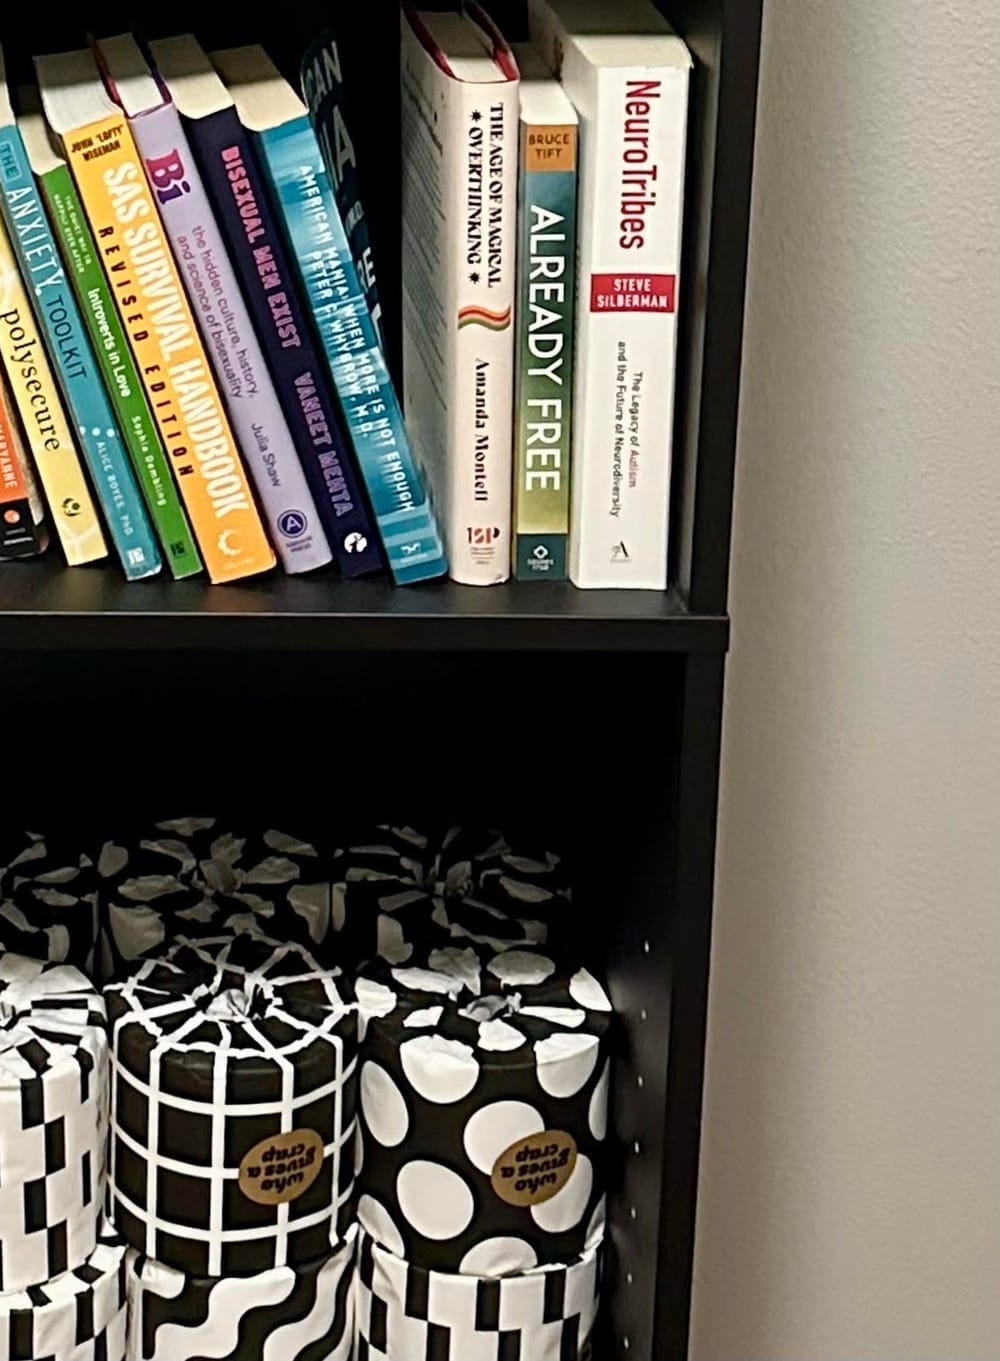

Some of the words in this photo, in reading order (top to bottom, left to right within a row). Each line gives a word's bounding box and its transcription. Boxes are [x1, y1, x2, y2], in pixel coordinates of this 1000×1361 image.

[0, 145, 18, 177] THE
[529, 133, 570, 146] BRUCE
[535, 147, 561, 160] TIFT
[620, 79, 660, 250] NeuroTribes
[102, 162, 150, 223] SAS
[145, 147, 191, 206] Bi
[220, 144, 257, 244] BISEXUAL
[466, 127, 484, 264] OVERTHINKING
[6, 187, 62, 290] ANXIETY
[175, 236, 192, 262] and
[252, 244, 282, 291] MEN
[121, 221, 187, 361] SURVIVAL
[184, 259, 212, 315] science
[192, 224, 206, 250] the
[203, 247, 225, 295] hidden
[216, 295, 242, 347] culture,
[235, 346, 261, 398] history,
[527, 204, 566, 385] ALREADY
[596, 293, 668, 309] SILBERMAN
[613, 278, 652, 293] STEVE
[45, 295, 87, 381] TOOLKIT
[205, 313, 219, 333] of
[266, 291, 302, 349] EXIST
[98, 226, 150, 344] REVISED
[145, 364, 194, 478] EDITION
[211, 330, 244, 400] bisexuality
[616, 363, 627, 384] the
[617, 340, 627, 364] and
[474, 357, 490, 435] Amanda
[615, 386, 627, 421] Future
[633, 371, 644, 394] The
[168, 359, 250, 518] HANDBOOK
[613, 422, 624, 436] of
[629, 394, 643, 432] Legacy
[630, 432, 641, 448] of
[131, 416, 149, 452] Sophia
[145, 455, 167, 507] Dembling
[251, 420, 269, 458] Julia
[261, 457, 282, 489] Shaw
[292, 369, 334, 447] VANEET
[318, 449, 354, 518] MEHTA
[473, 439, 490, 502] Montell
[525, 398, 562, 491] FREE
[628, 448, 641, 488] Autism
[608, 436, 623, 520] Neurodiversity
[262, 1143, 306, 1162] crap
[261, 1172, 305, 1194] who
